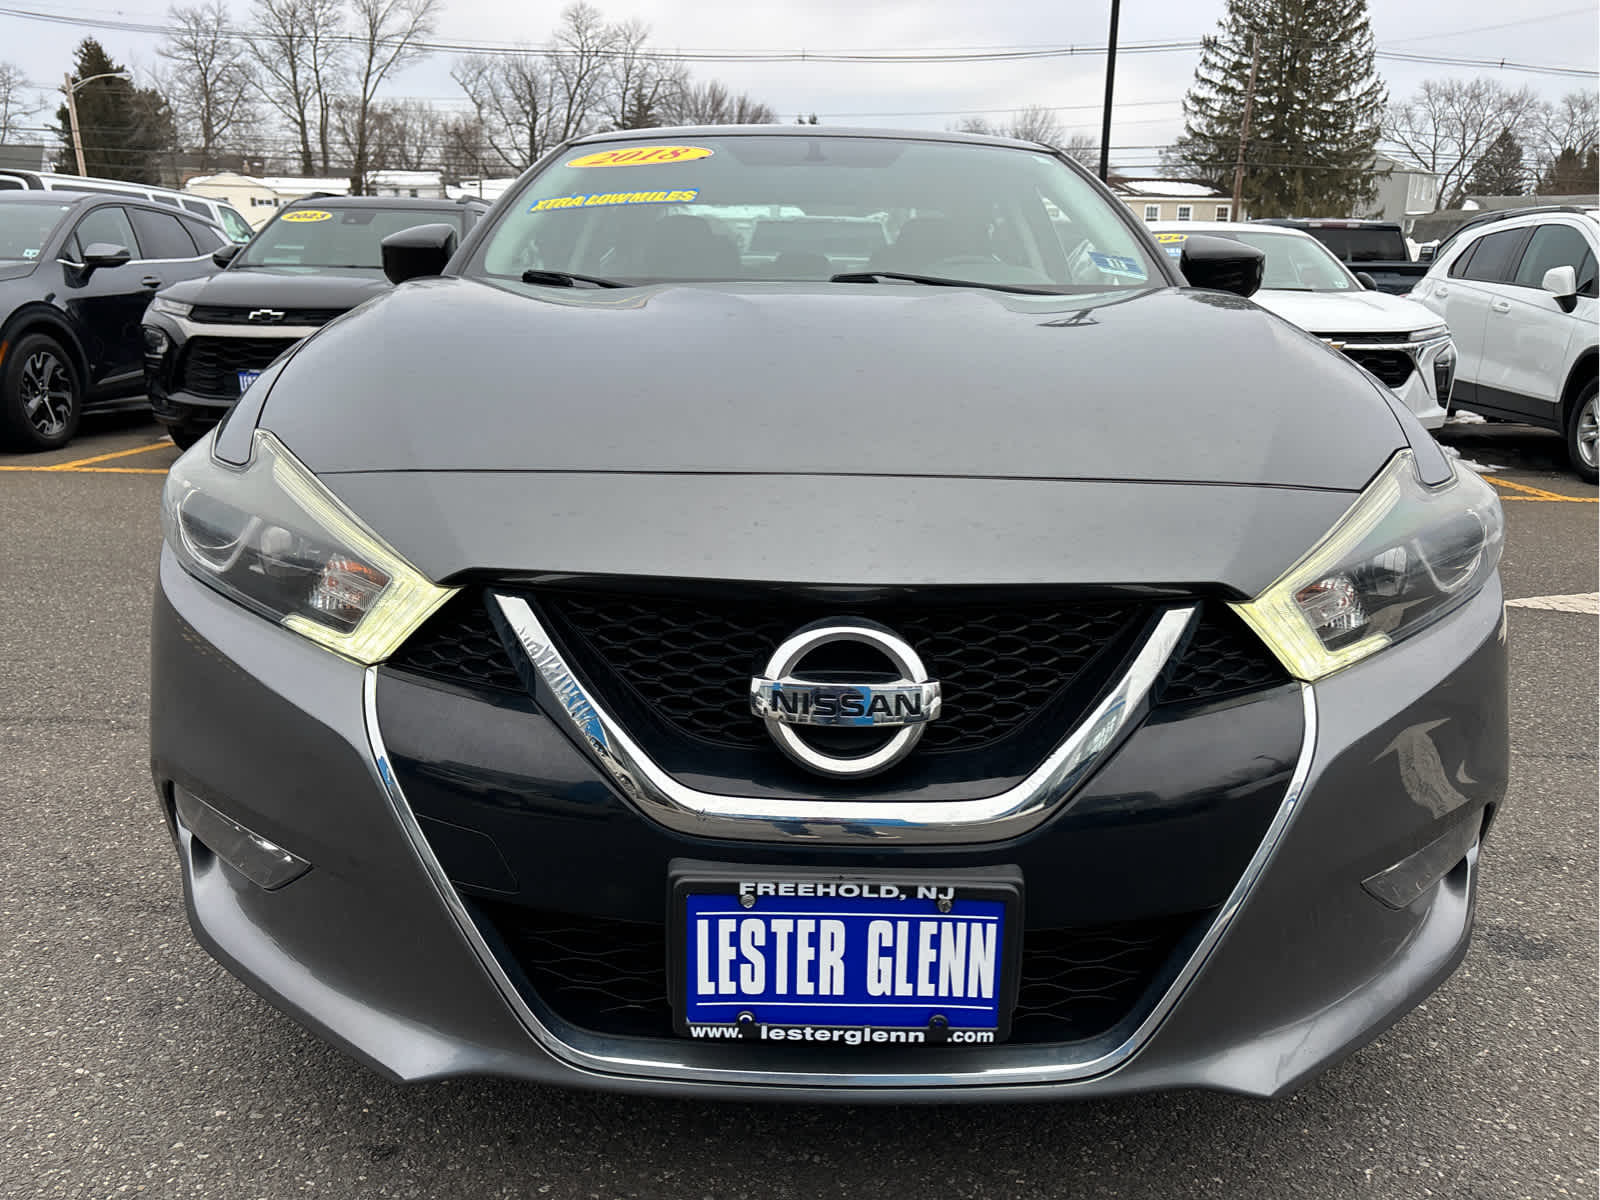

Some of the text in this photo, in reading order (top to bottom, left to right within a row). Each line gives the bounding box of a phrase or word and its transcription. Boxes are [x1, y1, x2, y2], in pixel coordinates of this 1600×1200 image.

[588, 147, 690, 166] 2018
[530, 196, 585, 212] XTRA
[771, 690, 922, 717] NISSAN
[739, 882, 955, 901] FREEHOLD, NJ
[696, 918, 998, 999] LESTER GLENN
[760, 1023, 925, 1045] lesterglenn
